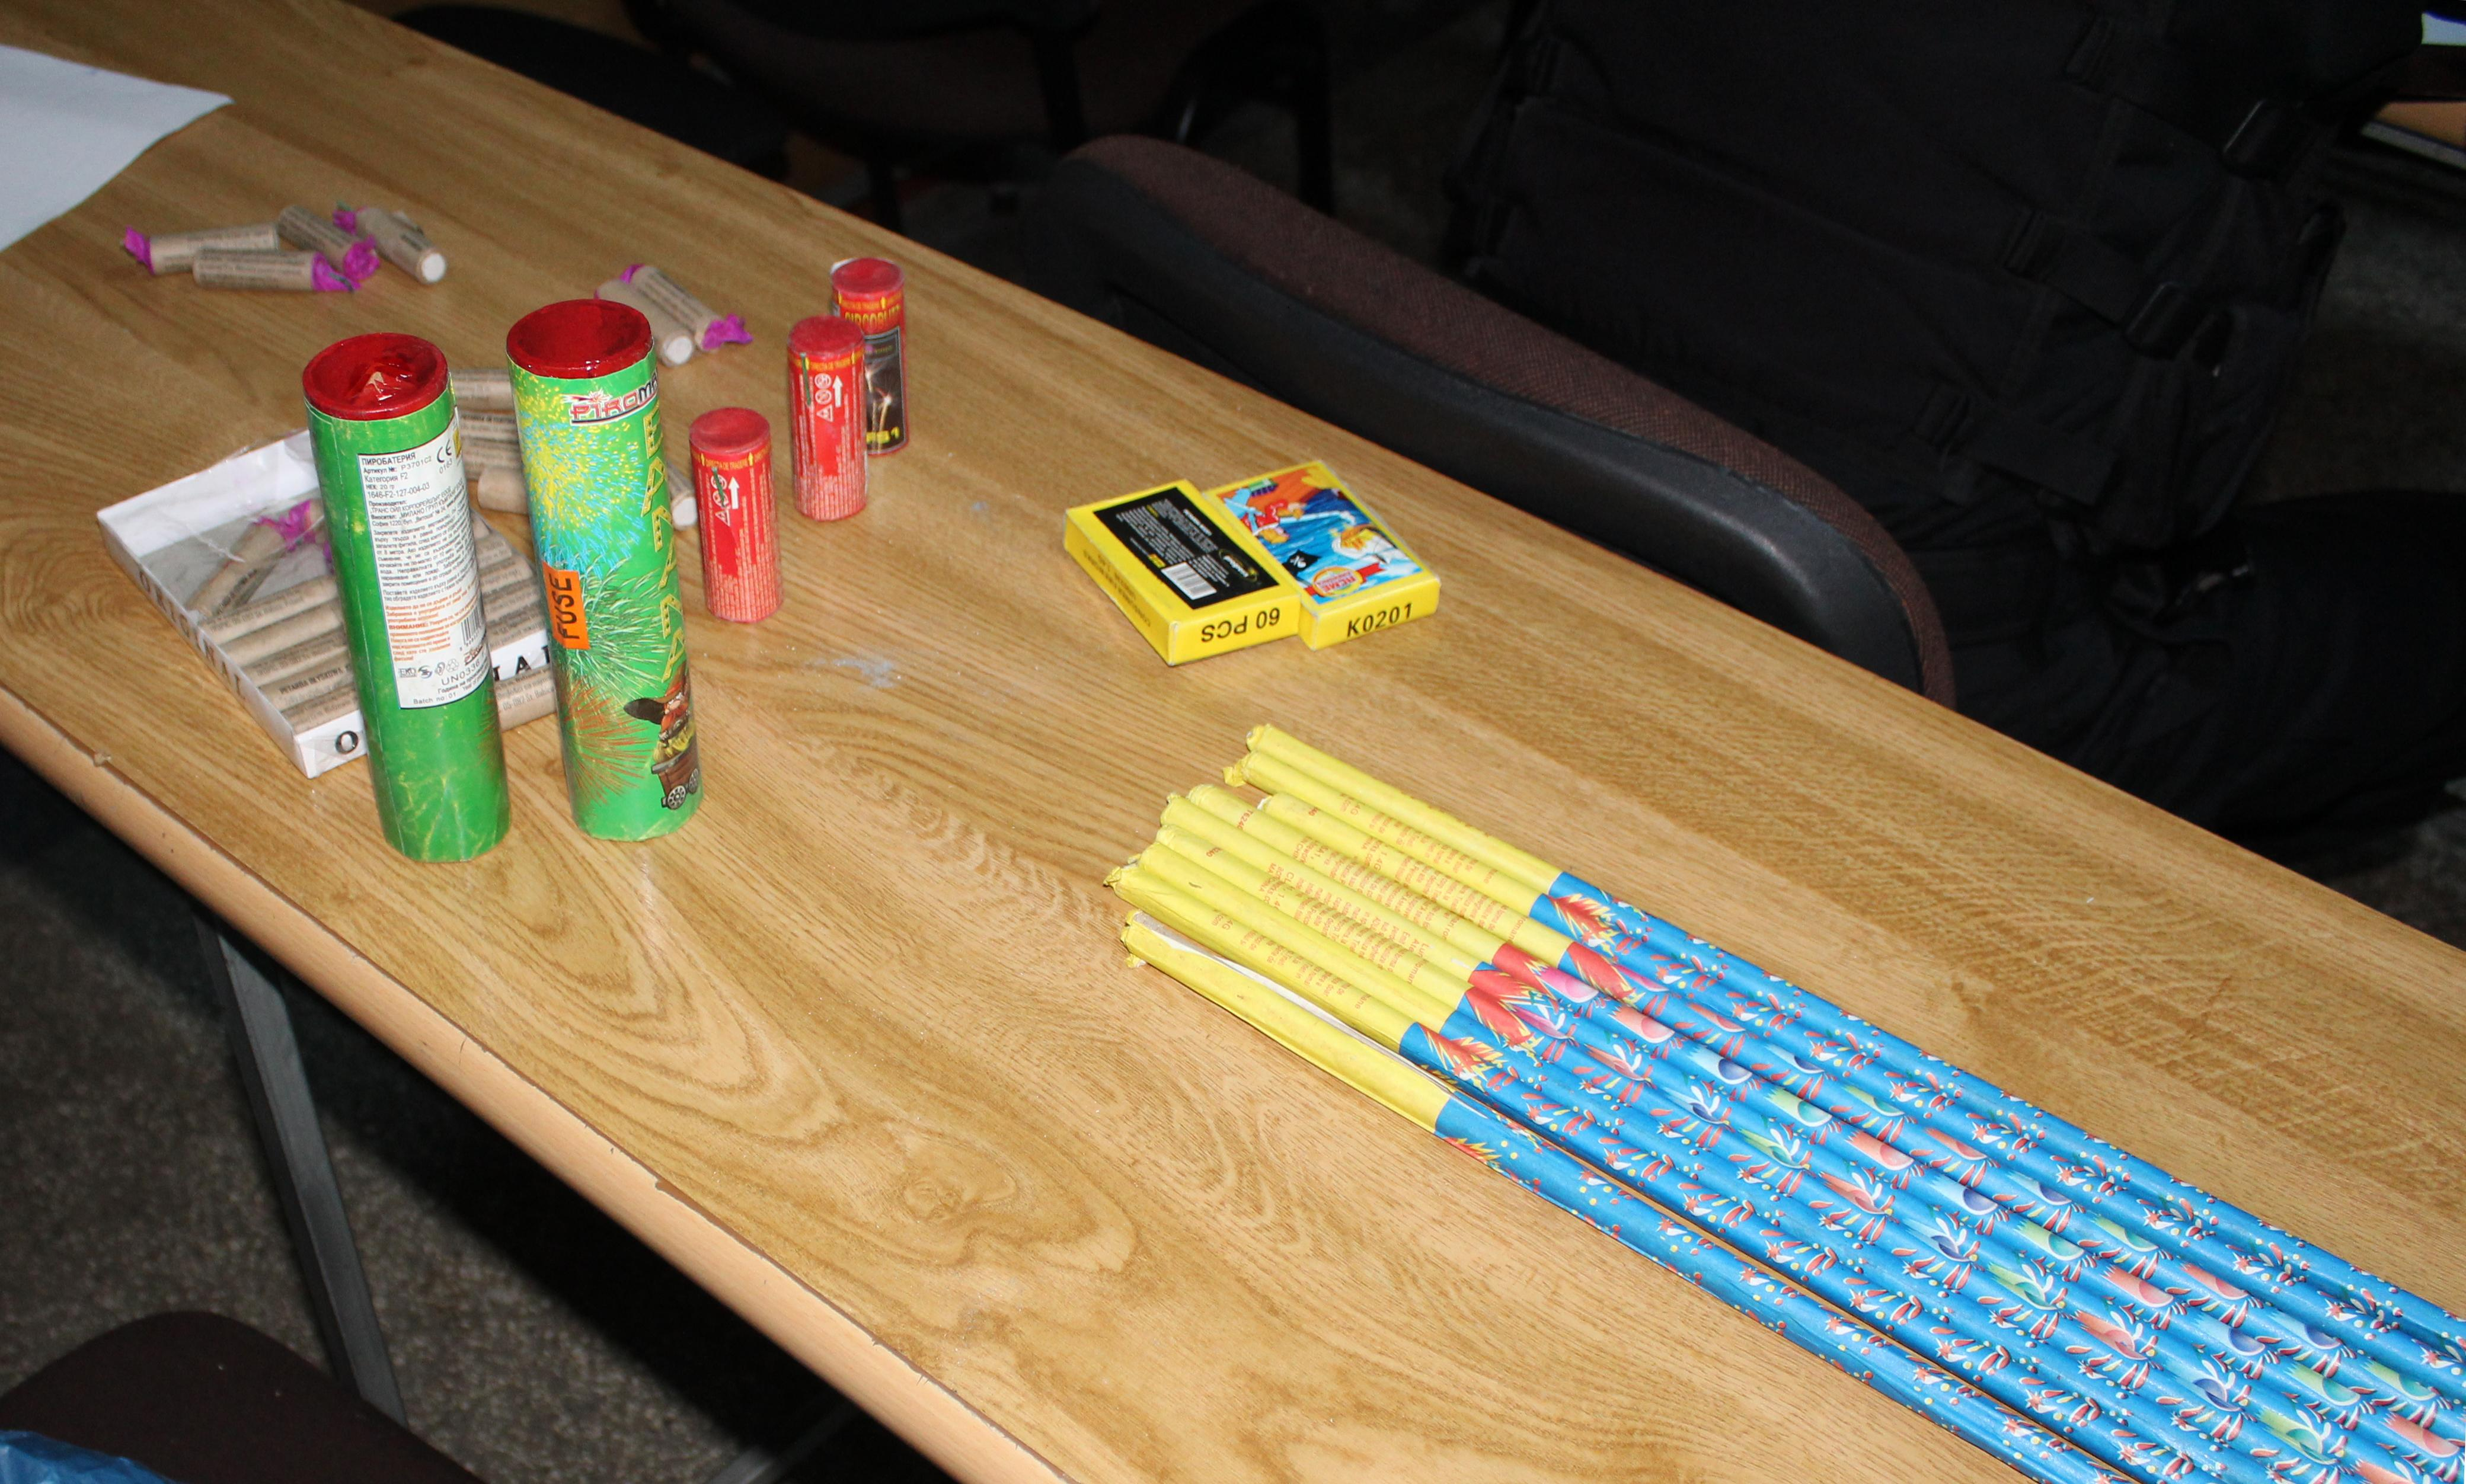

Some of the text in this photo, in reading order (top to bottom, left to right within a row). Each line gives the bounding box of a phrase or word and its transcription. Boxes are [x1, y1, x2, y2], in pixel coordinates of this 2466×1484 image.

[362, 452, 416, 466] ПИРОБАТЕРИЯ
[439, 459, 453, 474] 0163
[363, 466, 387, 475] Артикул
[400, 472, 408, 481] F2
[549, 573, 580, 640] FUSE
[1200, 607, 1281, 644] 60 PCS
[1347, 603, 1413, 638] K0201
[441, 659, 481, 686] UN0336
[437, 685, 459, 695] Година
